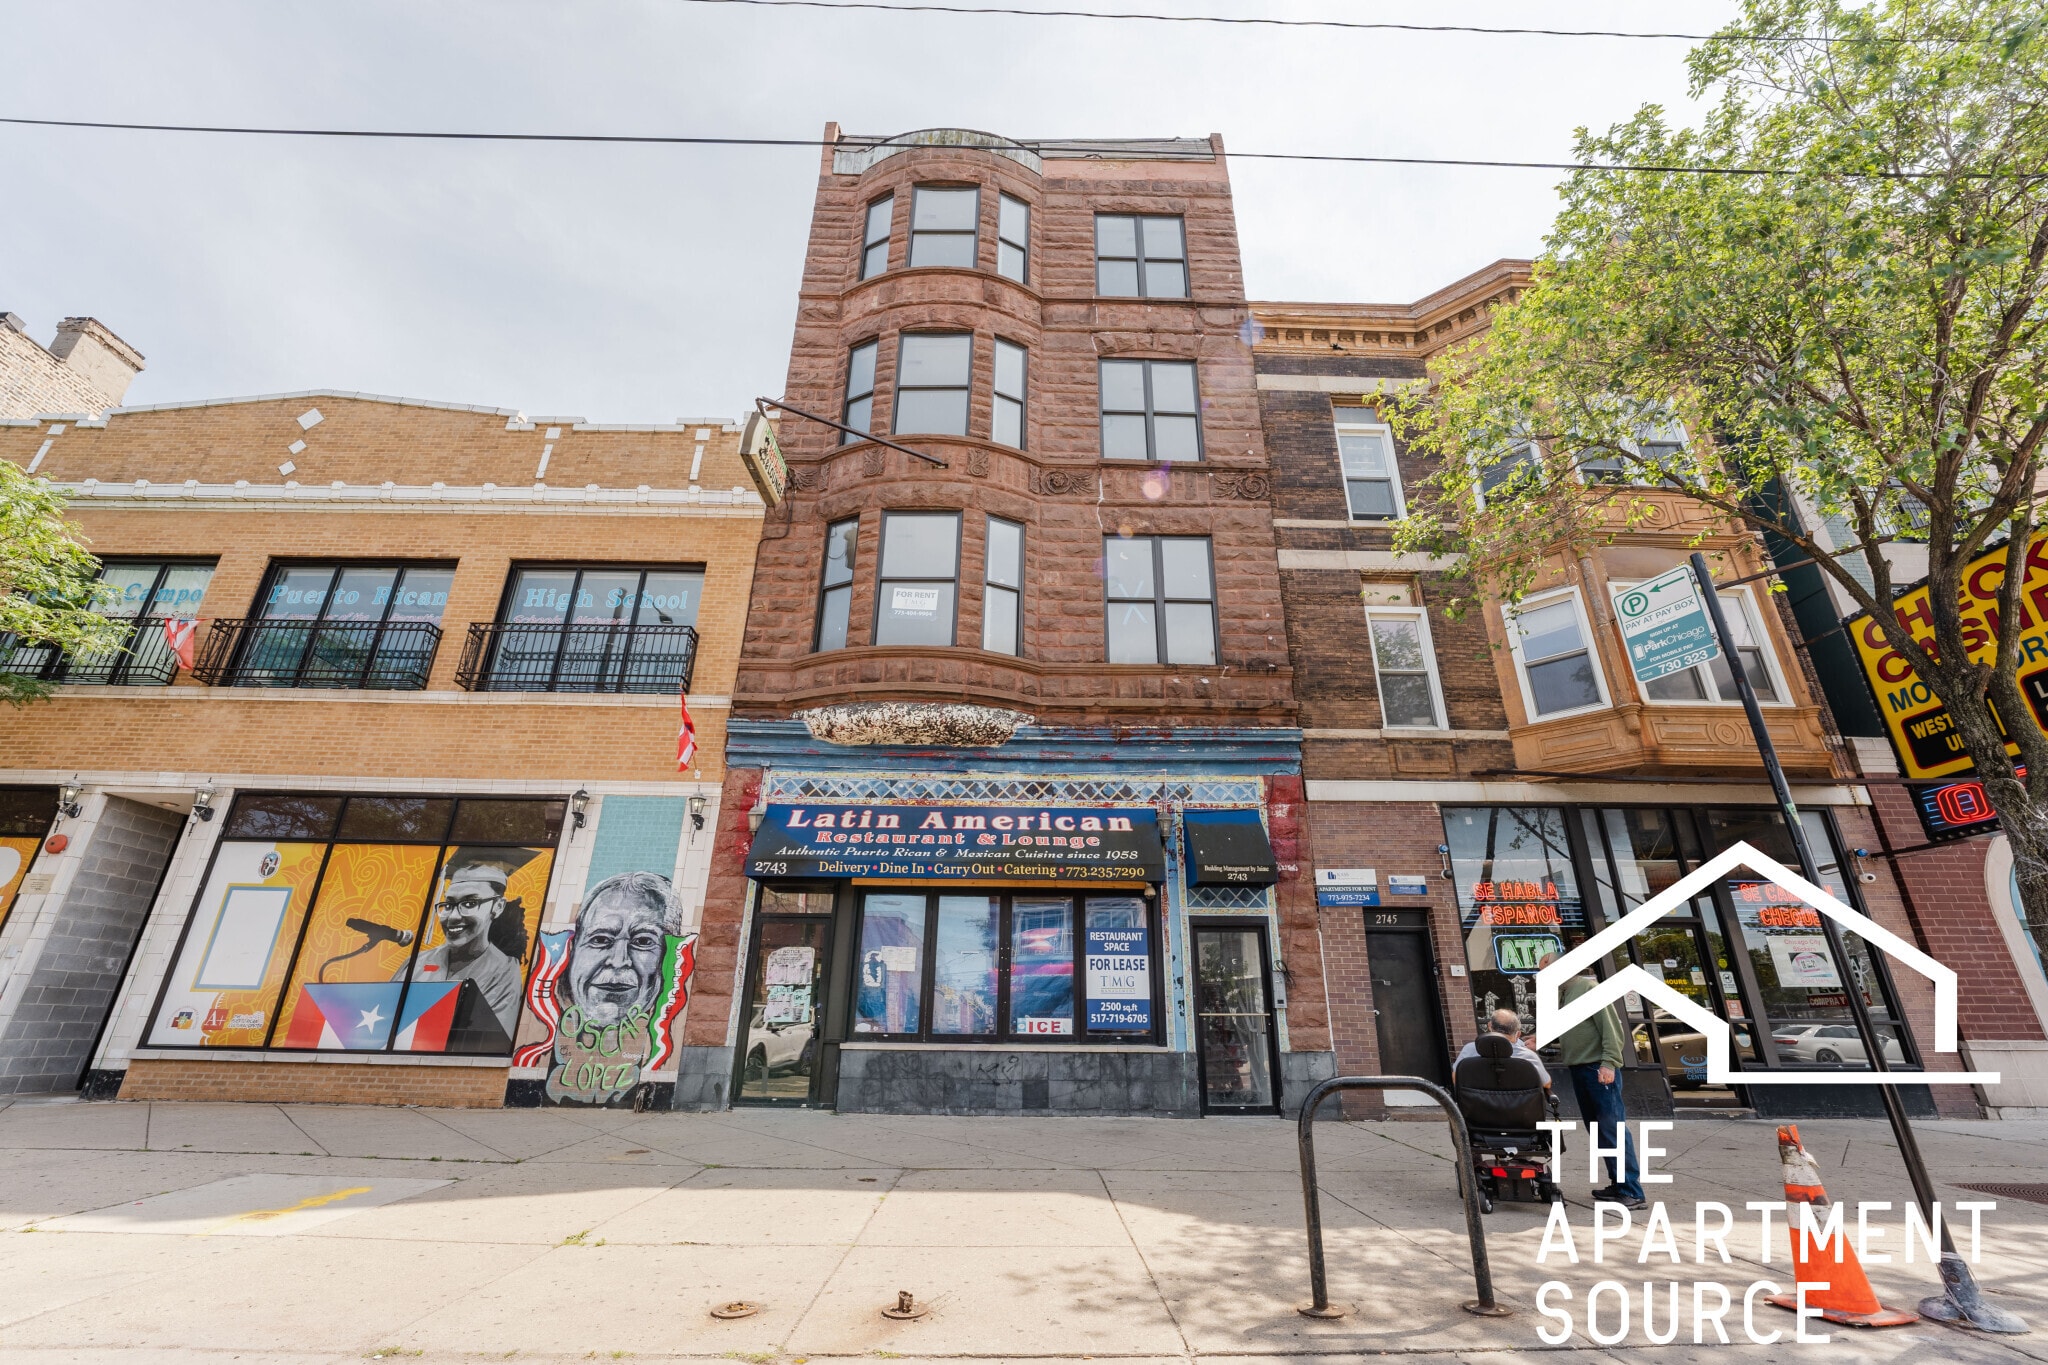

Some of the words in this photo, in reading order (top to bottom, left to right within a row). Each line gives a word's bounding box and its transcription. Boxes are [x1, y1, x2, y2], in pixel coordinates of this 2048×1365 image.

[269, 585, 359, 605] Puerto
[372, 586, 447, 606] Rican
[523, 588, 594, 611] High
[605, 589, 689, 609] School
[914, 591, 936, 599] RENT
[1625, 620, 1641, 631] PAY
[1643, 615, 1653, 623] AT
[1655, 607, 1672, 619] PAY
[1674, 598, 1695, 611] BOX
[1644, 626, 1705, 653] ParkChicago
[1661, 647, 1683, 658] MOBILE
[1682, 643, 1694, 651] PAY
[1658, 659, 1681, 673] 730
[1684, 650, 1708, 665] 323
[1910, 713, 1954, 739] WEST
[786, 809, 901, 829] Latin
[918, 811, 1134, 832] American
[815, 830, 966, 845] Restaurant
[976, 833, 998, 845] &
[1001, 834, 1101, 849] Lounge
[775, 845, 841, 856] Authentic
[842, 846, 890, 857] Puerto
[892, 848, 931, 857] Rican
[935, 848, 947, 857] &
[953, 848, 1011, 858] Mexican
[1014, 849, 1064, 859] Cuisine
[1066, 850, 1101, 859] since
[1105, 850, 1139, 860] 1958
[754, 861, 787, 875] 2743
[818, 861, 870, 876] Delivery
[879, 862, 909, 874] Dine
[911, 862, 925, 874] In
[933, 863, 969, 877] Carry
[971, 863, 995, 875] Out
[1004, 863, 1057, 877] Catering
[1065, 866, 1145, 879] 773.235.7290
[1227, 873, 1248, 881] 2743
[1473, 881, 1496, 901] SE
[1500, 881, 1560, 900] HABLA
[1739, 883, 1762, 902] SE
[1375, 914, 1398, 925] 2745
[1480, 903, 1563, 925] ESPAÑOL
[1759, 907, 1822, 927] CHEQUE
[1089, 931, 1143, 941] RESTAURANT
[1783, 938, 1808, 946] Chicago
[1809, 938, 1822, 946] City
[1103, 942, 1130, 952] SPACE
[1089, 958, 1111, 971] FOR
[1113, 958, 1146, 971] LEASE
[1100, 1002, 1121, 1011] 2500
[1122, 1003, 1138, 1013] sq.ft
[1028, 1021, 1061, 1034] ICE
[1090, 1014, 1148, 1023] 517-719-6705
[561, 1003, 650, 1058] OSCAR
